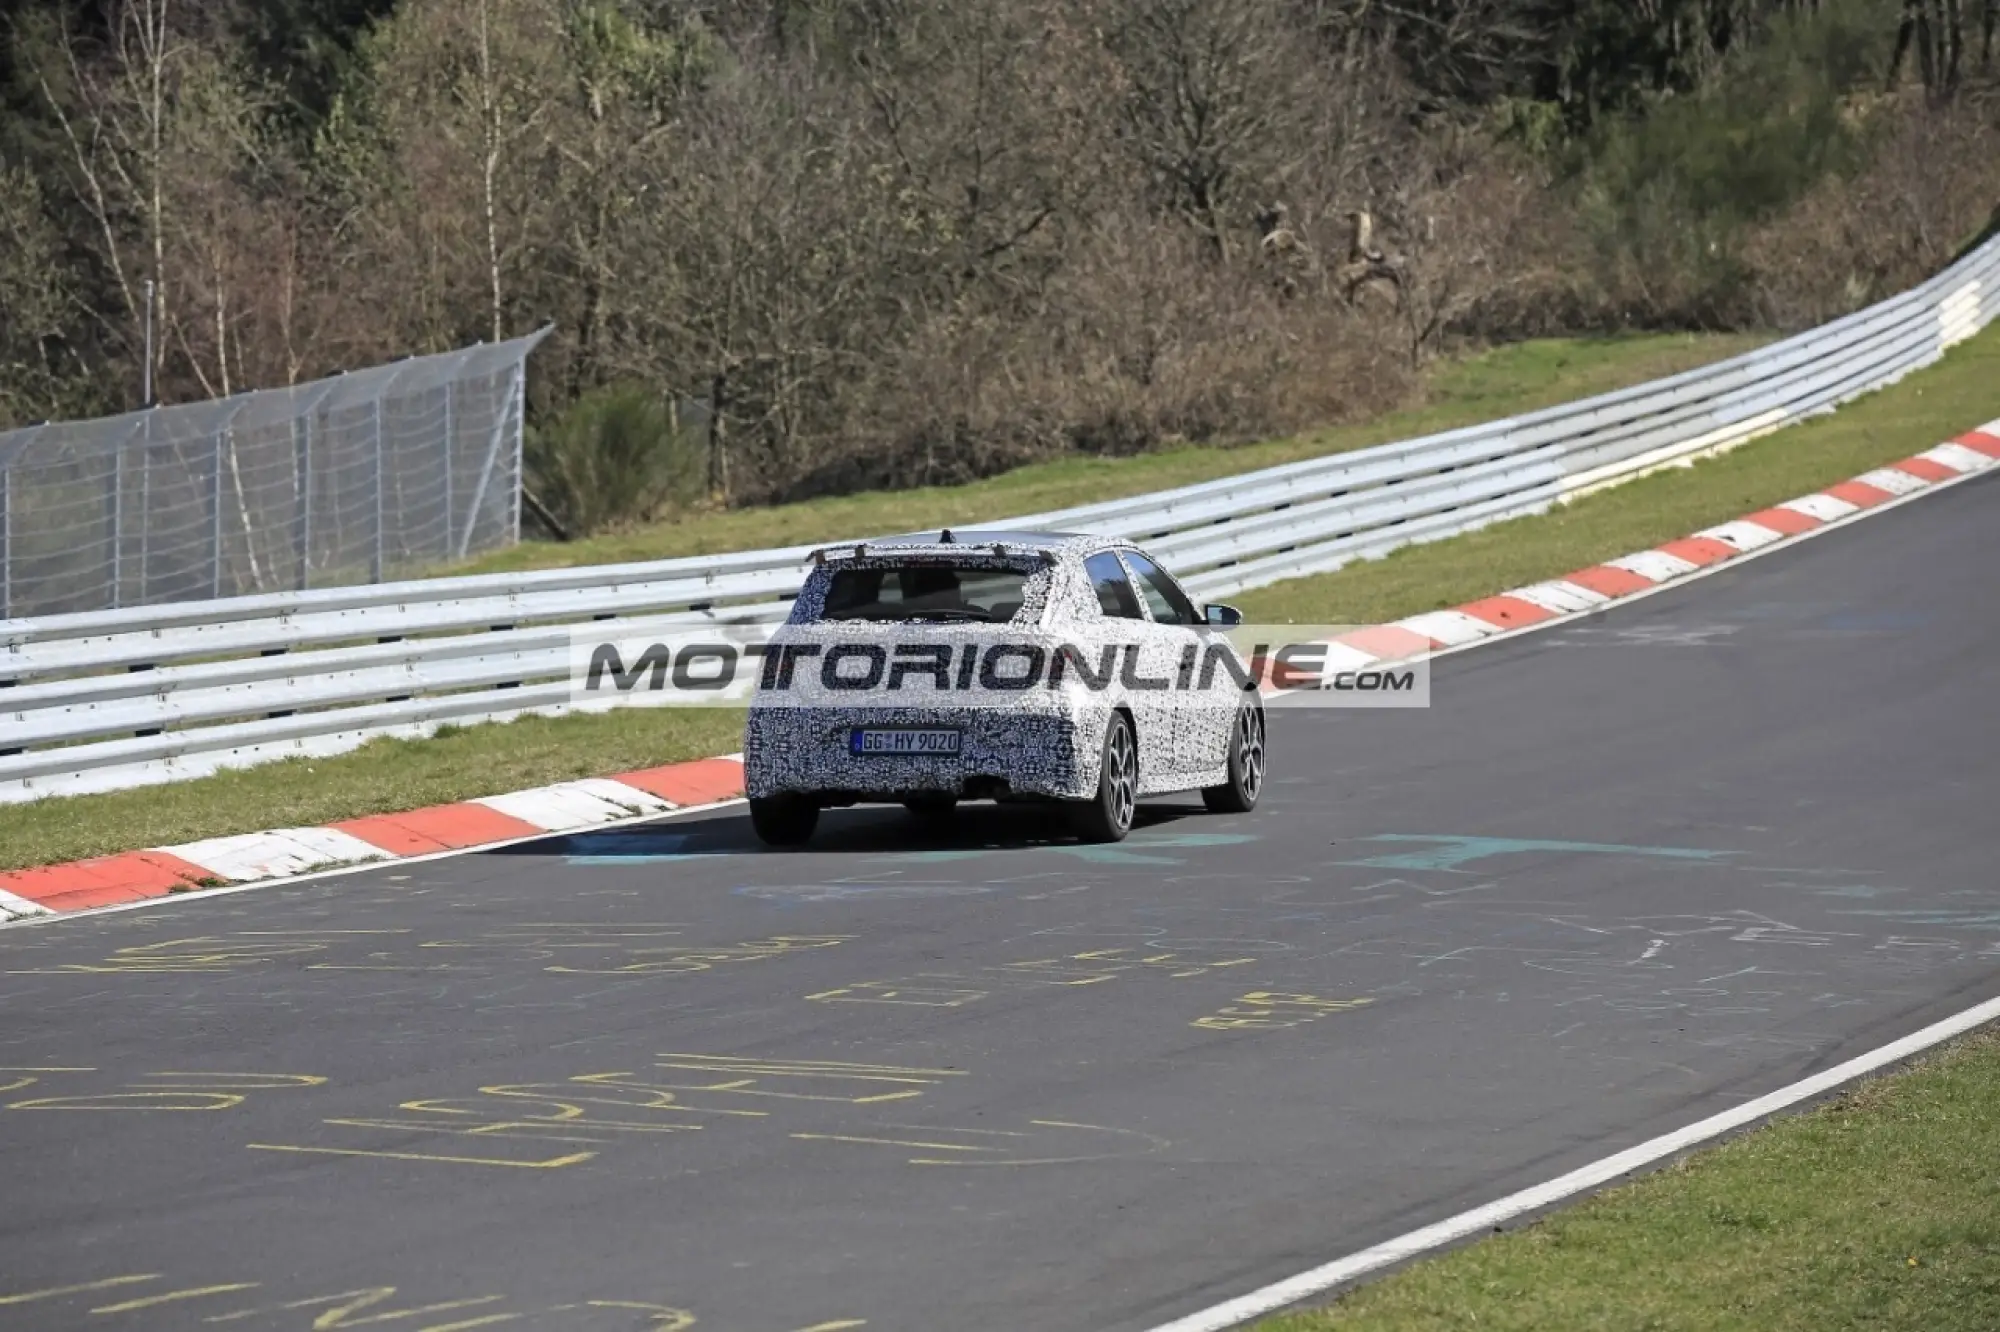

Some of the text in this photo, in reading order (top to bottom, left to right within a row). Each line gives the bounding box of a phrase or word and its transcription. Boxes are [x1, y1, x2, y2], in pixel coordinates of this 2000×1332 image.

[864, 733, 883, 750] GG
[895, 733, 915, 750] HY
[918, 733, 957, 750] 9020
